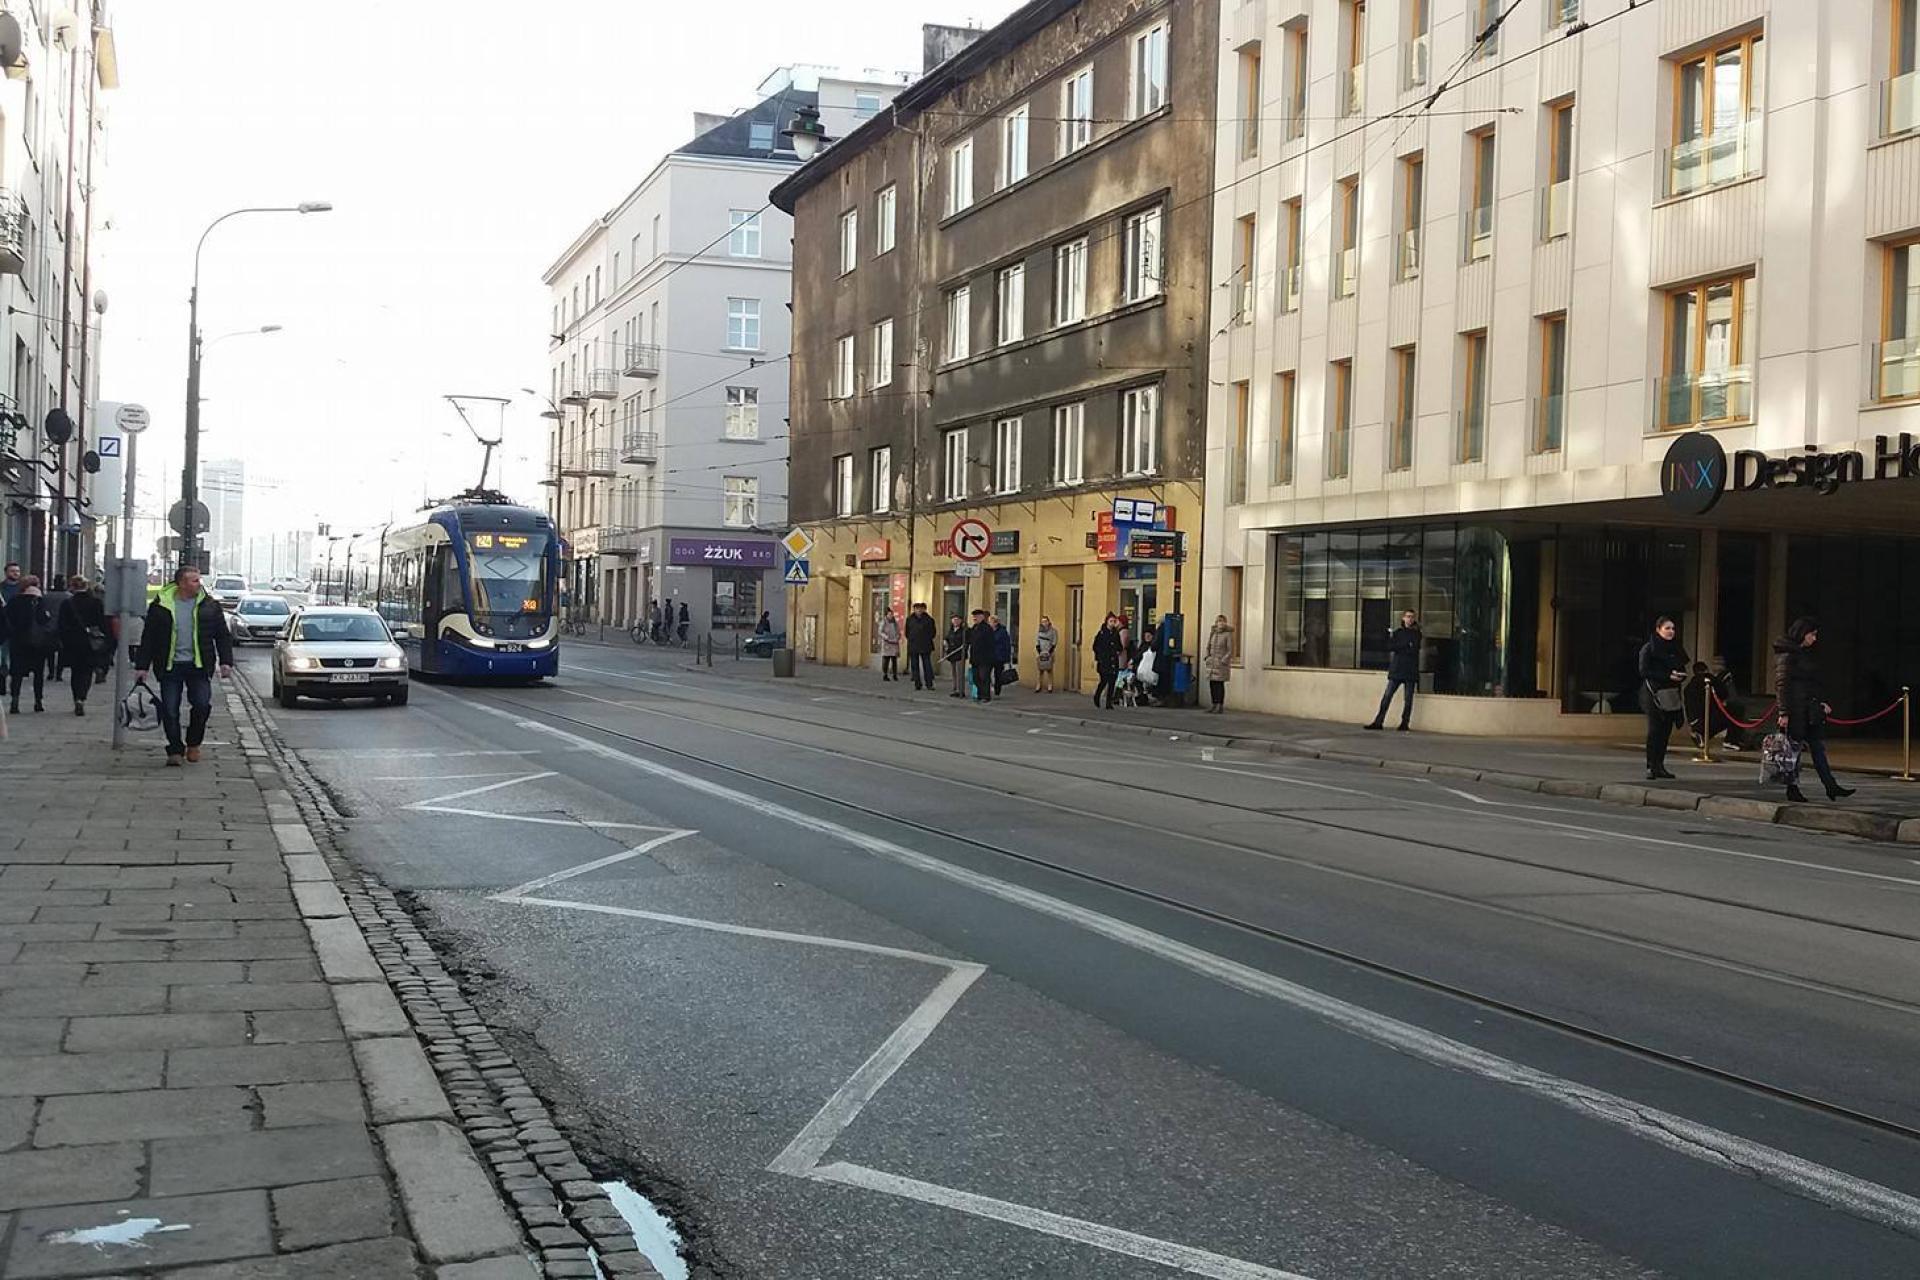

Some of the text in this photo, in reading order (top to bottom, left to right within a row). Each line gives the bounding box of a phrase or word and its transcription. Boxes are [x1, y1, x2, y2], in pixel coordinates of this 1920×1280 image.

[1669, 458, 1714, 493] INX
[1733, 444, 1864, 496] Design
[703, 544, 744, 560] ŻŻUK
